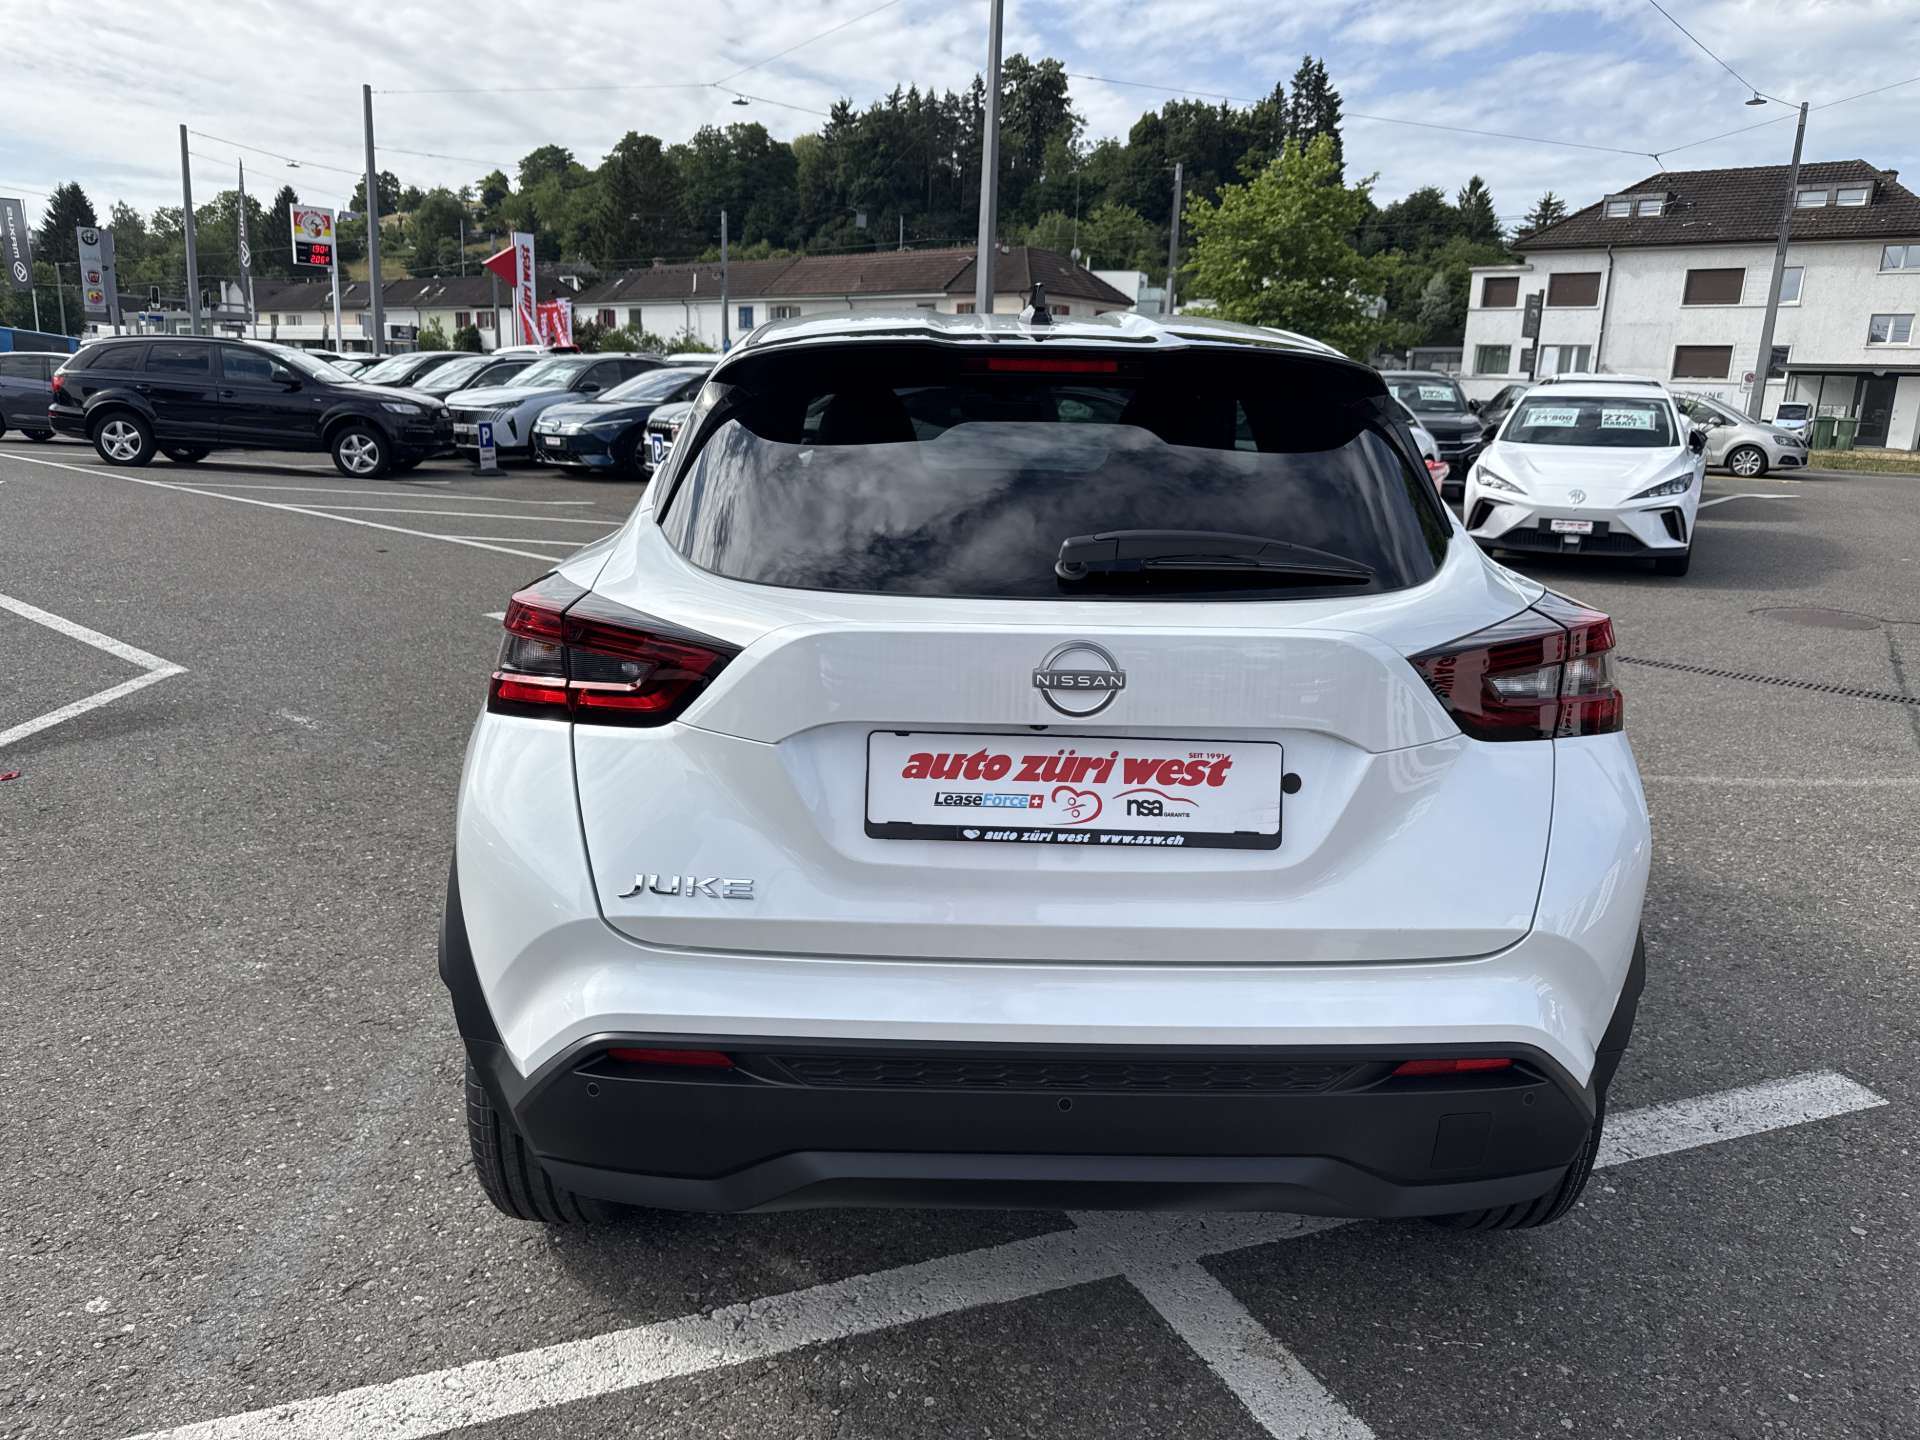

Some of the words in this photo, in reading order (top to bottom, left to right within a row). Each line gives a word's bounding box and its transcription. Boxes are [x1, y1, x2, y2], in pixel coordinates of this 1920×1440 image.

[482, 427, 490, 445] P
[654, 440, 661, 461] P
[1036, 674, 1123, 687] NISSAN
[901, 748, 1013, 781] auto
[1011, 749, 1119, 784] züri
[1123, 754, 1233, 787] west
[934, 792, 1028, 808] LeaseForce
[1126, 799, 1163, 816] nsa
[984, 830, 1018, 841] auto
[1021, 830, 1052, 842] züri
[1057, 832, 1090, 843] west
[1100, 834, 1185, 846] www.azw.ch
[616, 873, 754, 900] JUKE
